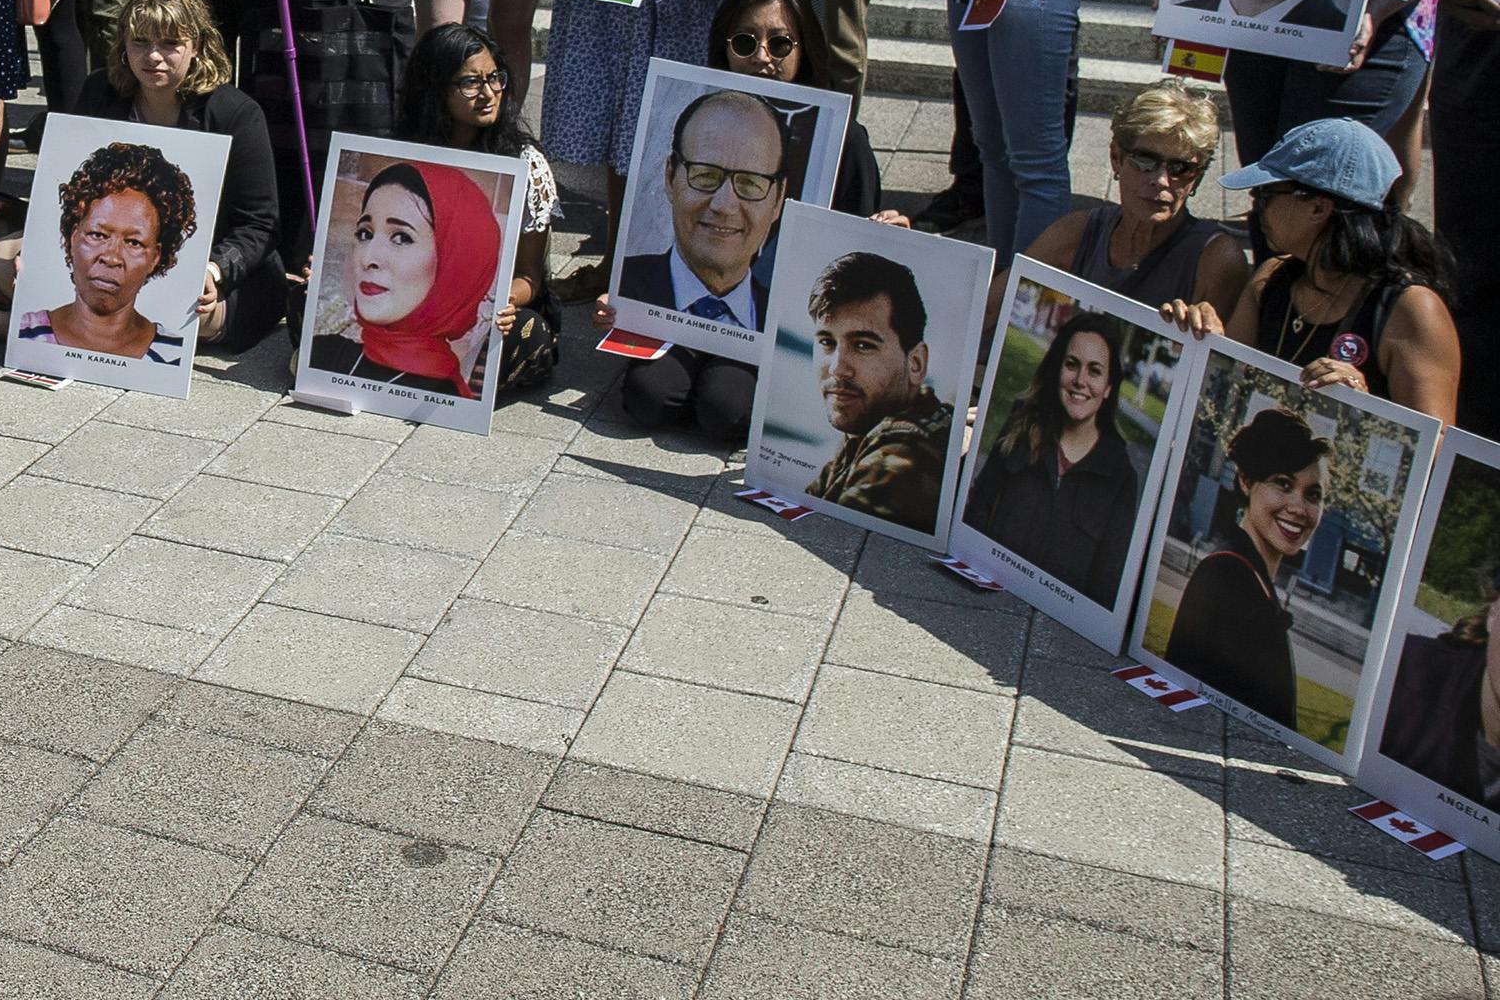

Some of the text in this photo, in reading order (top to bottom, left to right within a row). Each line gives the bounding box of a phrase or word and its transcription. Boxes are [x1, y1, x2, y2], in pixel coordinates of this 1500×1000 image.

[1199, 14, 1304, 38] JORDI DALMAU SAYOL
[648, 308, 755, 342] DR. BEN AHMED CHIHAB
[65, 351, 127, 368] ANN KARANJA
[331, 376, 455, 407] DOAA ATEF ABDEL SALAM
[1038, 576, 1075, 604] LACROIX
[1245, 710, 1281, 738] Moore
[1436, 792, 1490, 825] ANGELA
